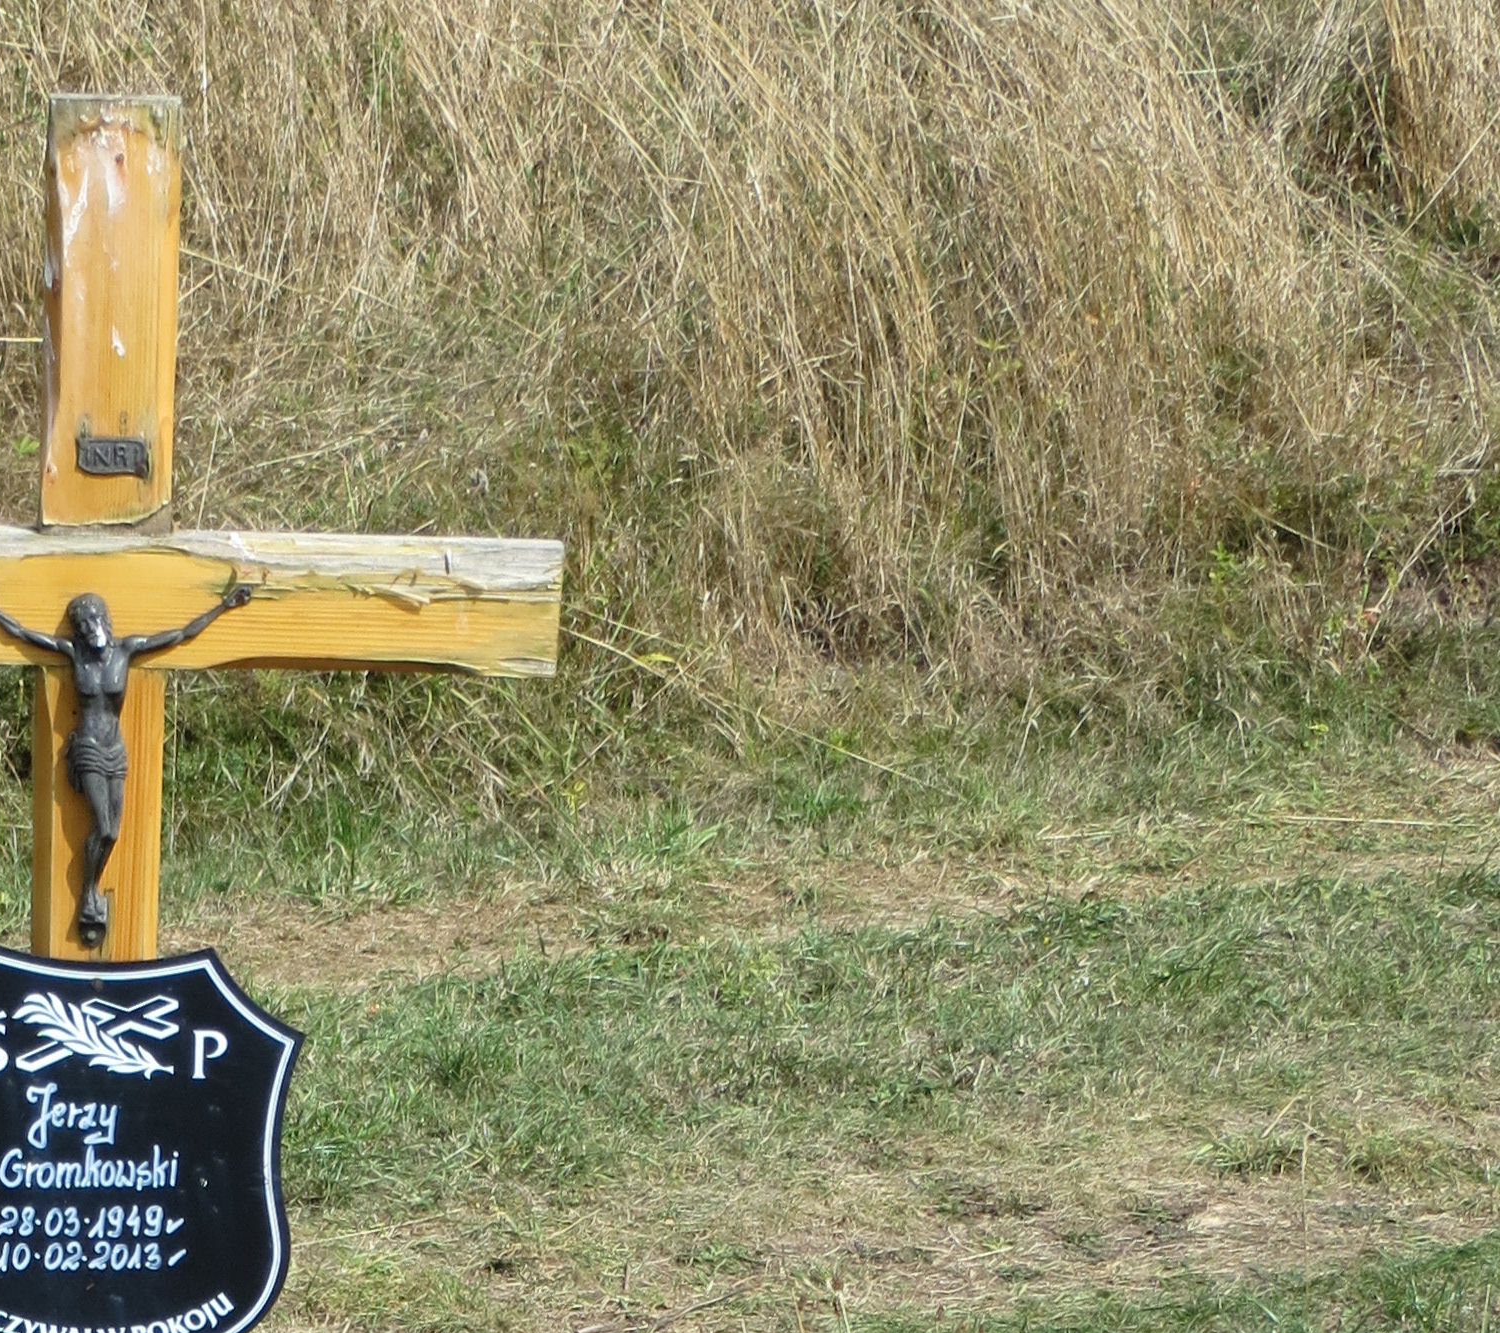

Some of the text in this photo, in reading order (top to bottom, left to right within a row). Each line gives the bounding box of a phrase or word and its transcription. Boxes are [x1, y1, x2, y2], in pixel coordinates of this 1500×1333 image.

[192, 1029, 229, 1080] P
[26, 1082, 119, 1150] Jerzy
[0, 1144, 180, 1192] Gromkowski
